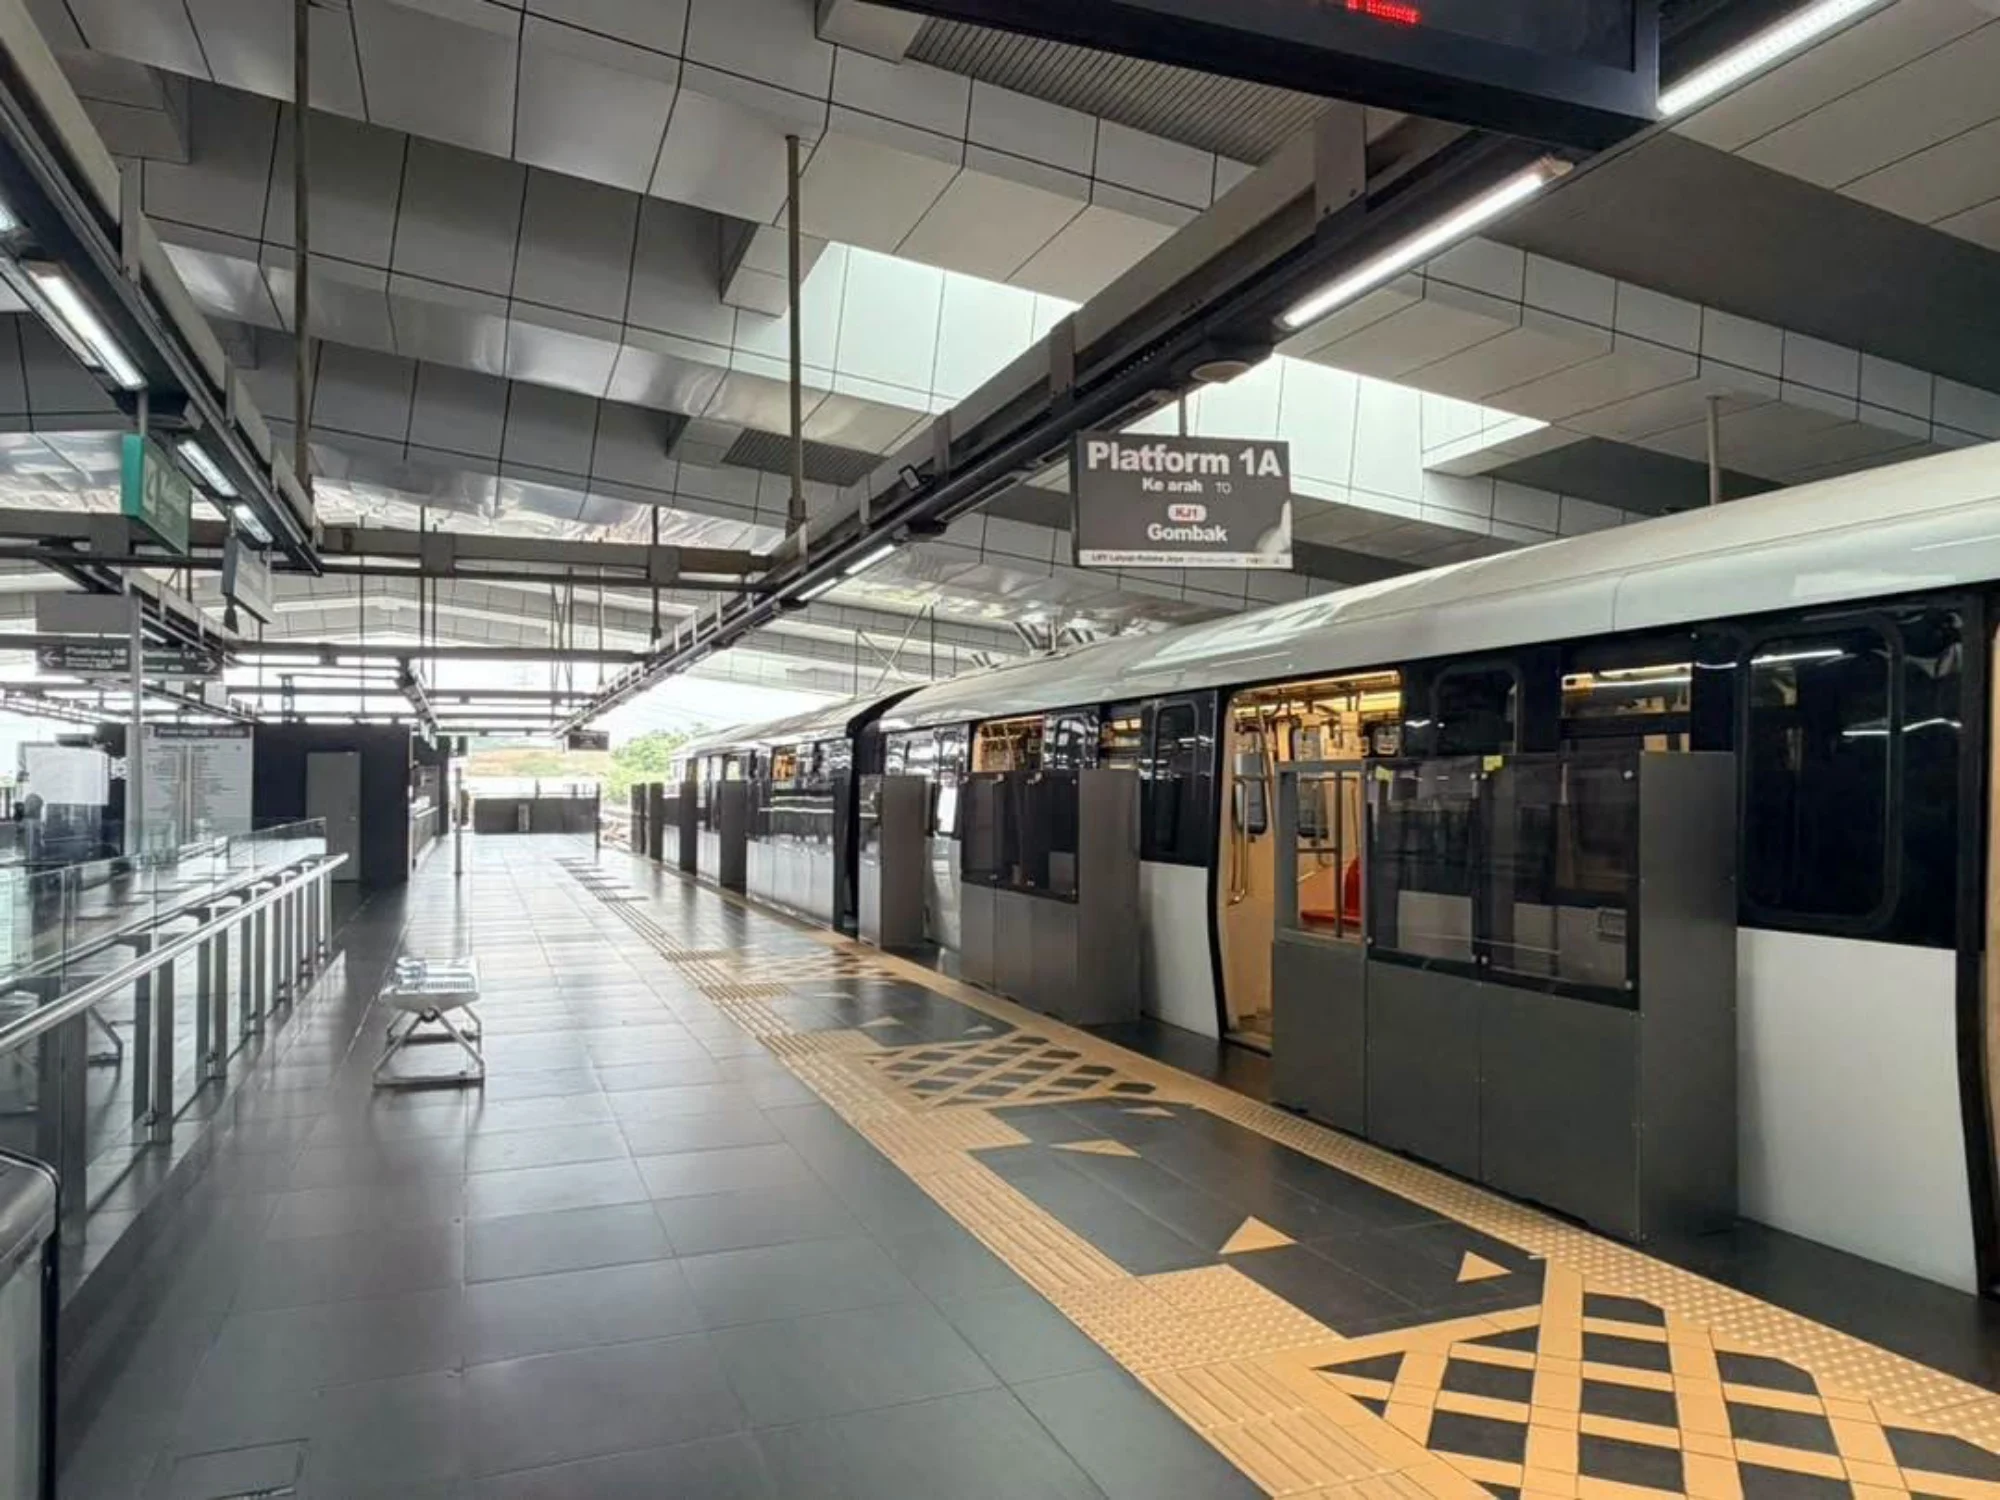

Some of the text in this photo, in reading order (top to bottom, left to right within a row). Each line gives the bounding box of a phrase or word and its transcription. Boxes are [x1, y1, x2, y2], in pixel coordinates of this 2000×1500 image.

[1087, 441, 1282, 477] Platform 1A
[1142, 477, 1165, 491] Ke
[1168, 479, 1203, 493] arah
[1147, 523, 1228, 542] Gombak
